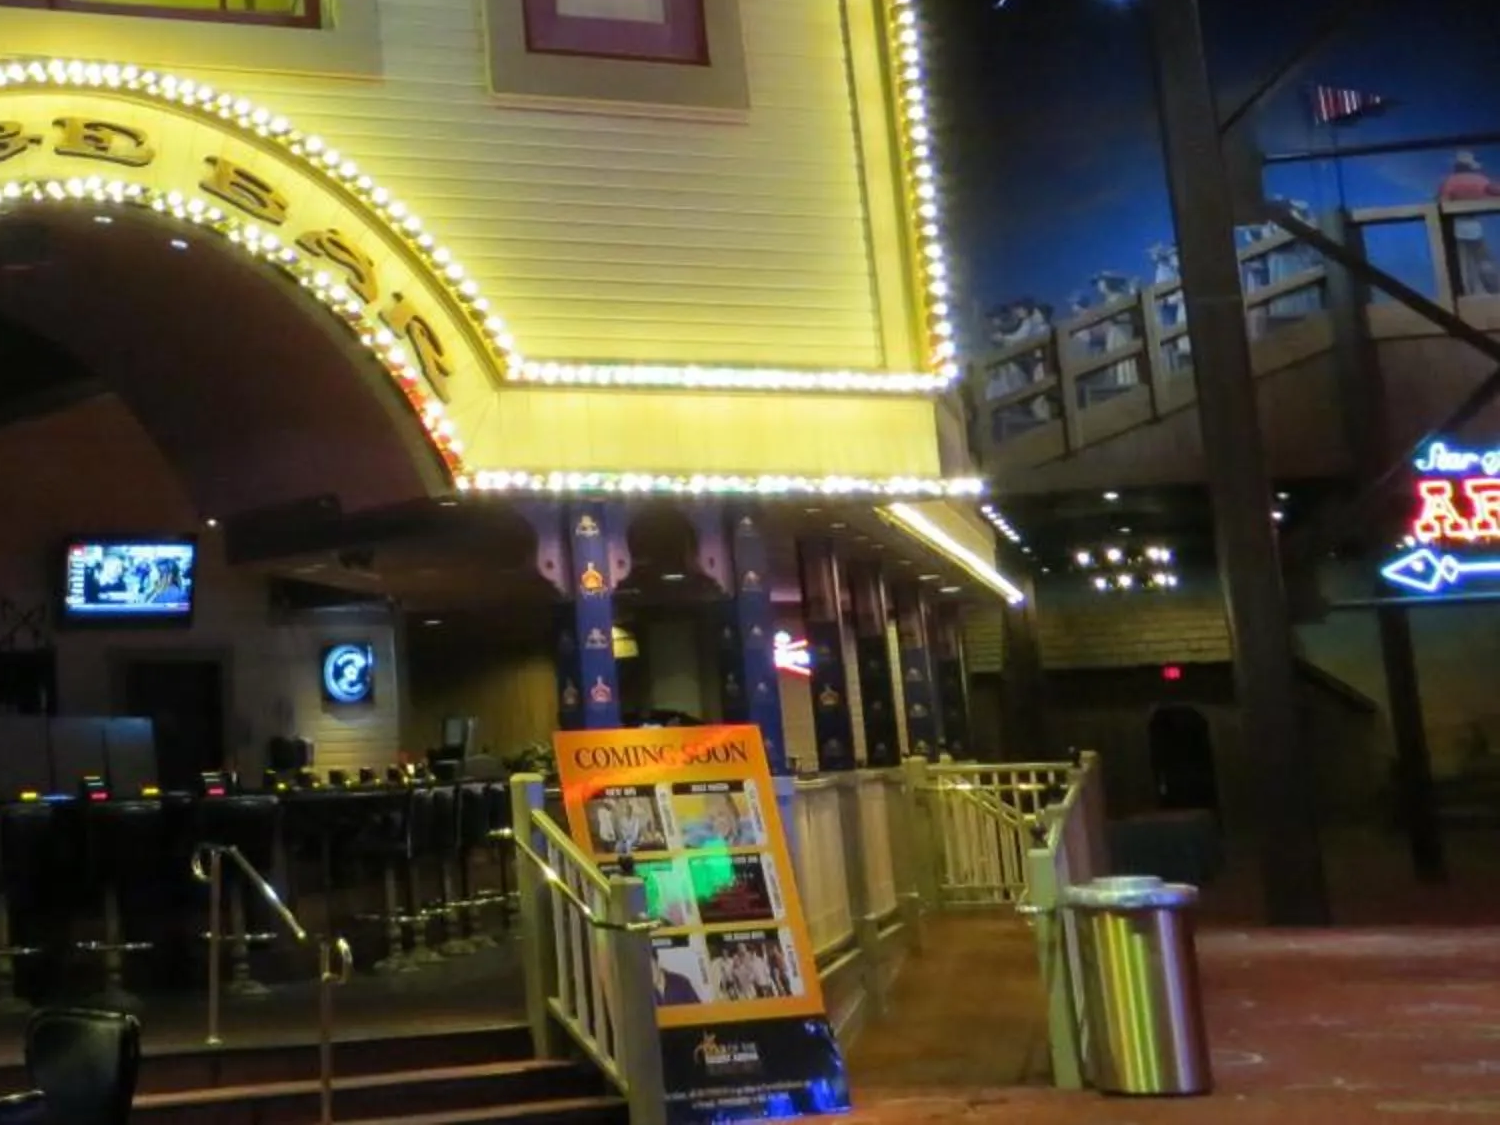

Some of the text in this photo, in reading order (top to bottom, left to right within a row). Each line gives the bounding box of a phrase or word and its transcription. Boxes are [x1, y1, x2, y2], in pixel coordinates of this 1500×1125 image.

[198, 155, 453, 404] BAR
[1415, 441, 1479, 471] Star
[574, 740, 749, 771] COMING SOON
